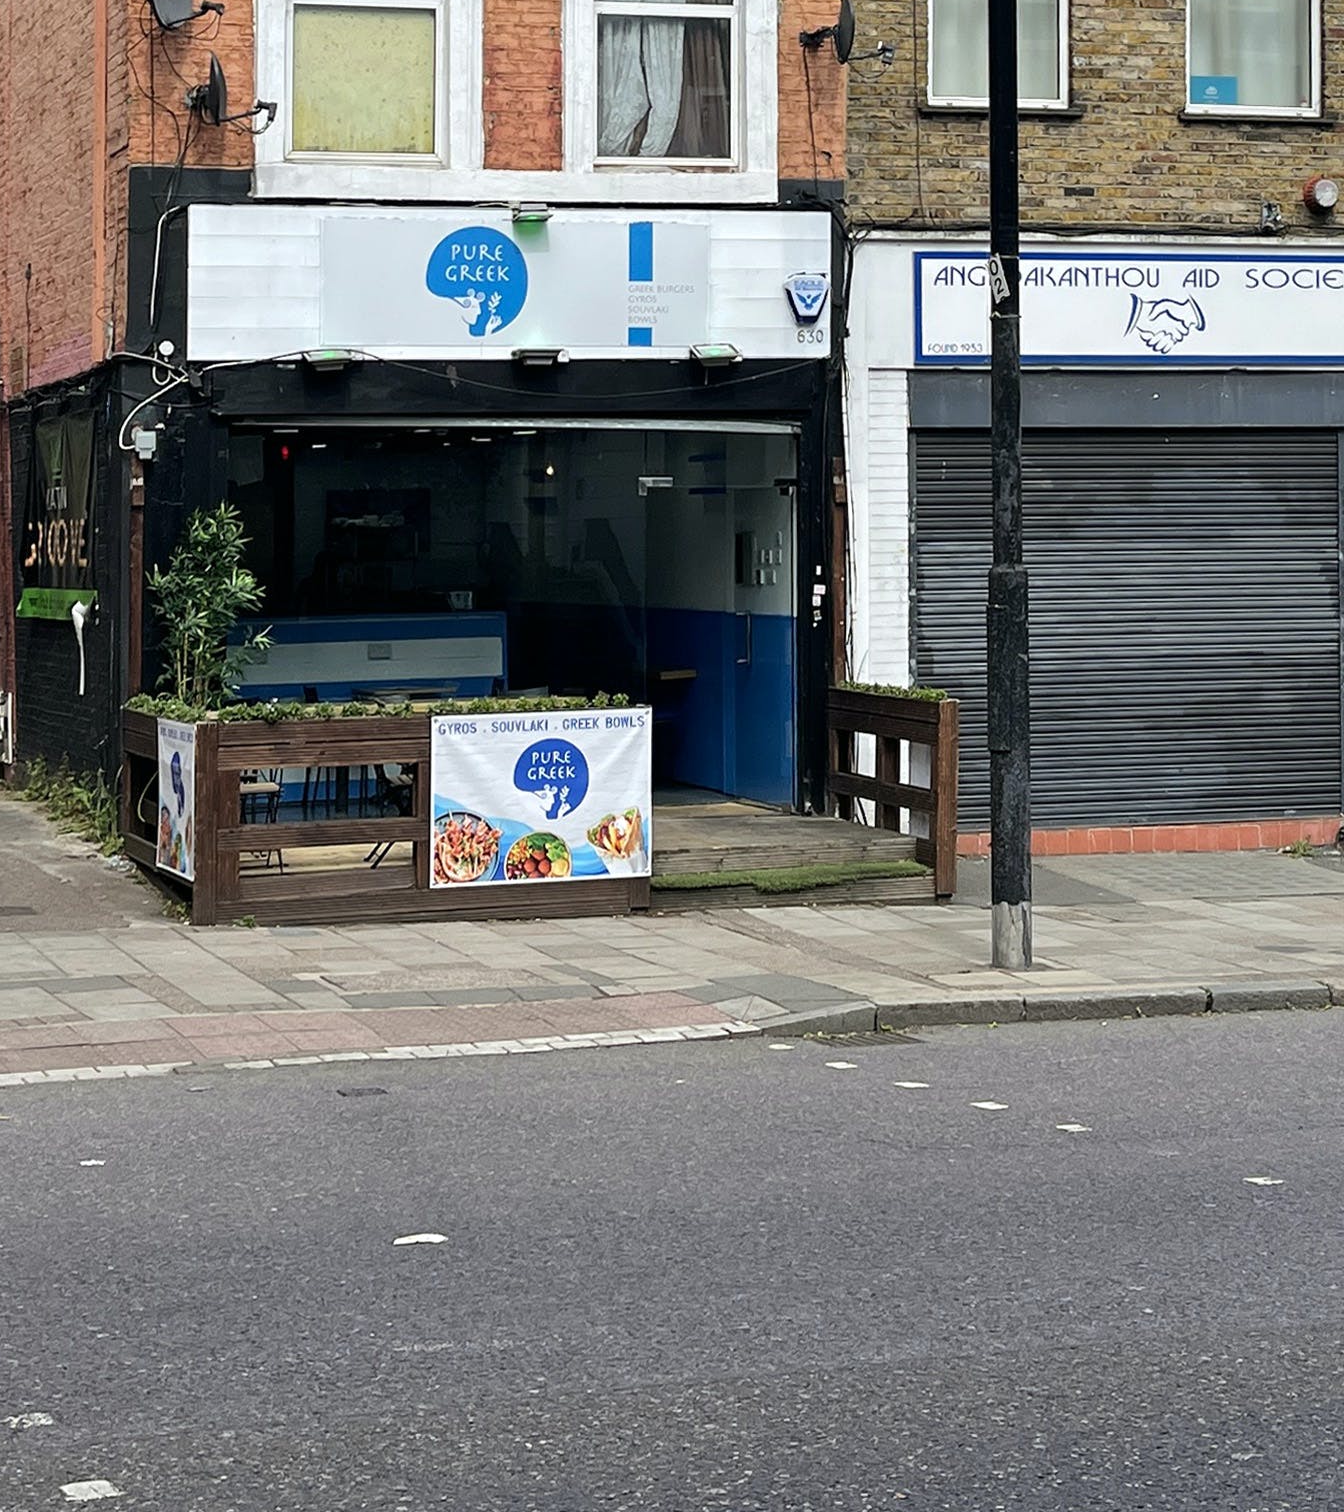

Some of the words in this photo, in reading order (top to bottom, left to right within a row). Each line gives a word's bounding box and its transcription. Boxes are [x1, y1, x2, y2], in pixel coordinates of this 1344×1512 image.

[451, 244, 503, 261] PURE
[445, 265, 509, 282] GREEK
[1183, 268, 1219, 288] AID
[628, 284, 655, 293] GREEK
[657, 284, 695, 293] BURGERS
[628, 295, 657, 303] GYROS
[628, 305, 669, 314] SOUVLAKI
[628, 315, 657, 324] BOWLS
[797, 330, 824, 344] 630
[438, 722, 477, 735] GYROS
[491, 719, 549, 733] SOUVLAKI
[562, 717, 599, 730] GREEK
[606, 715, 645, 729] BOWLS
[532, 750, 571, 764] PURE
[528, 765, 576, 781] GREEK
